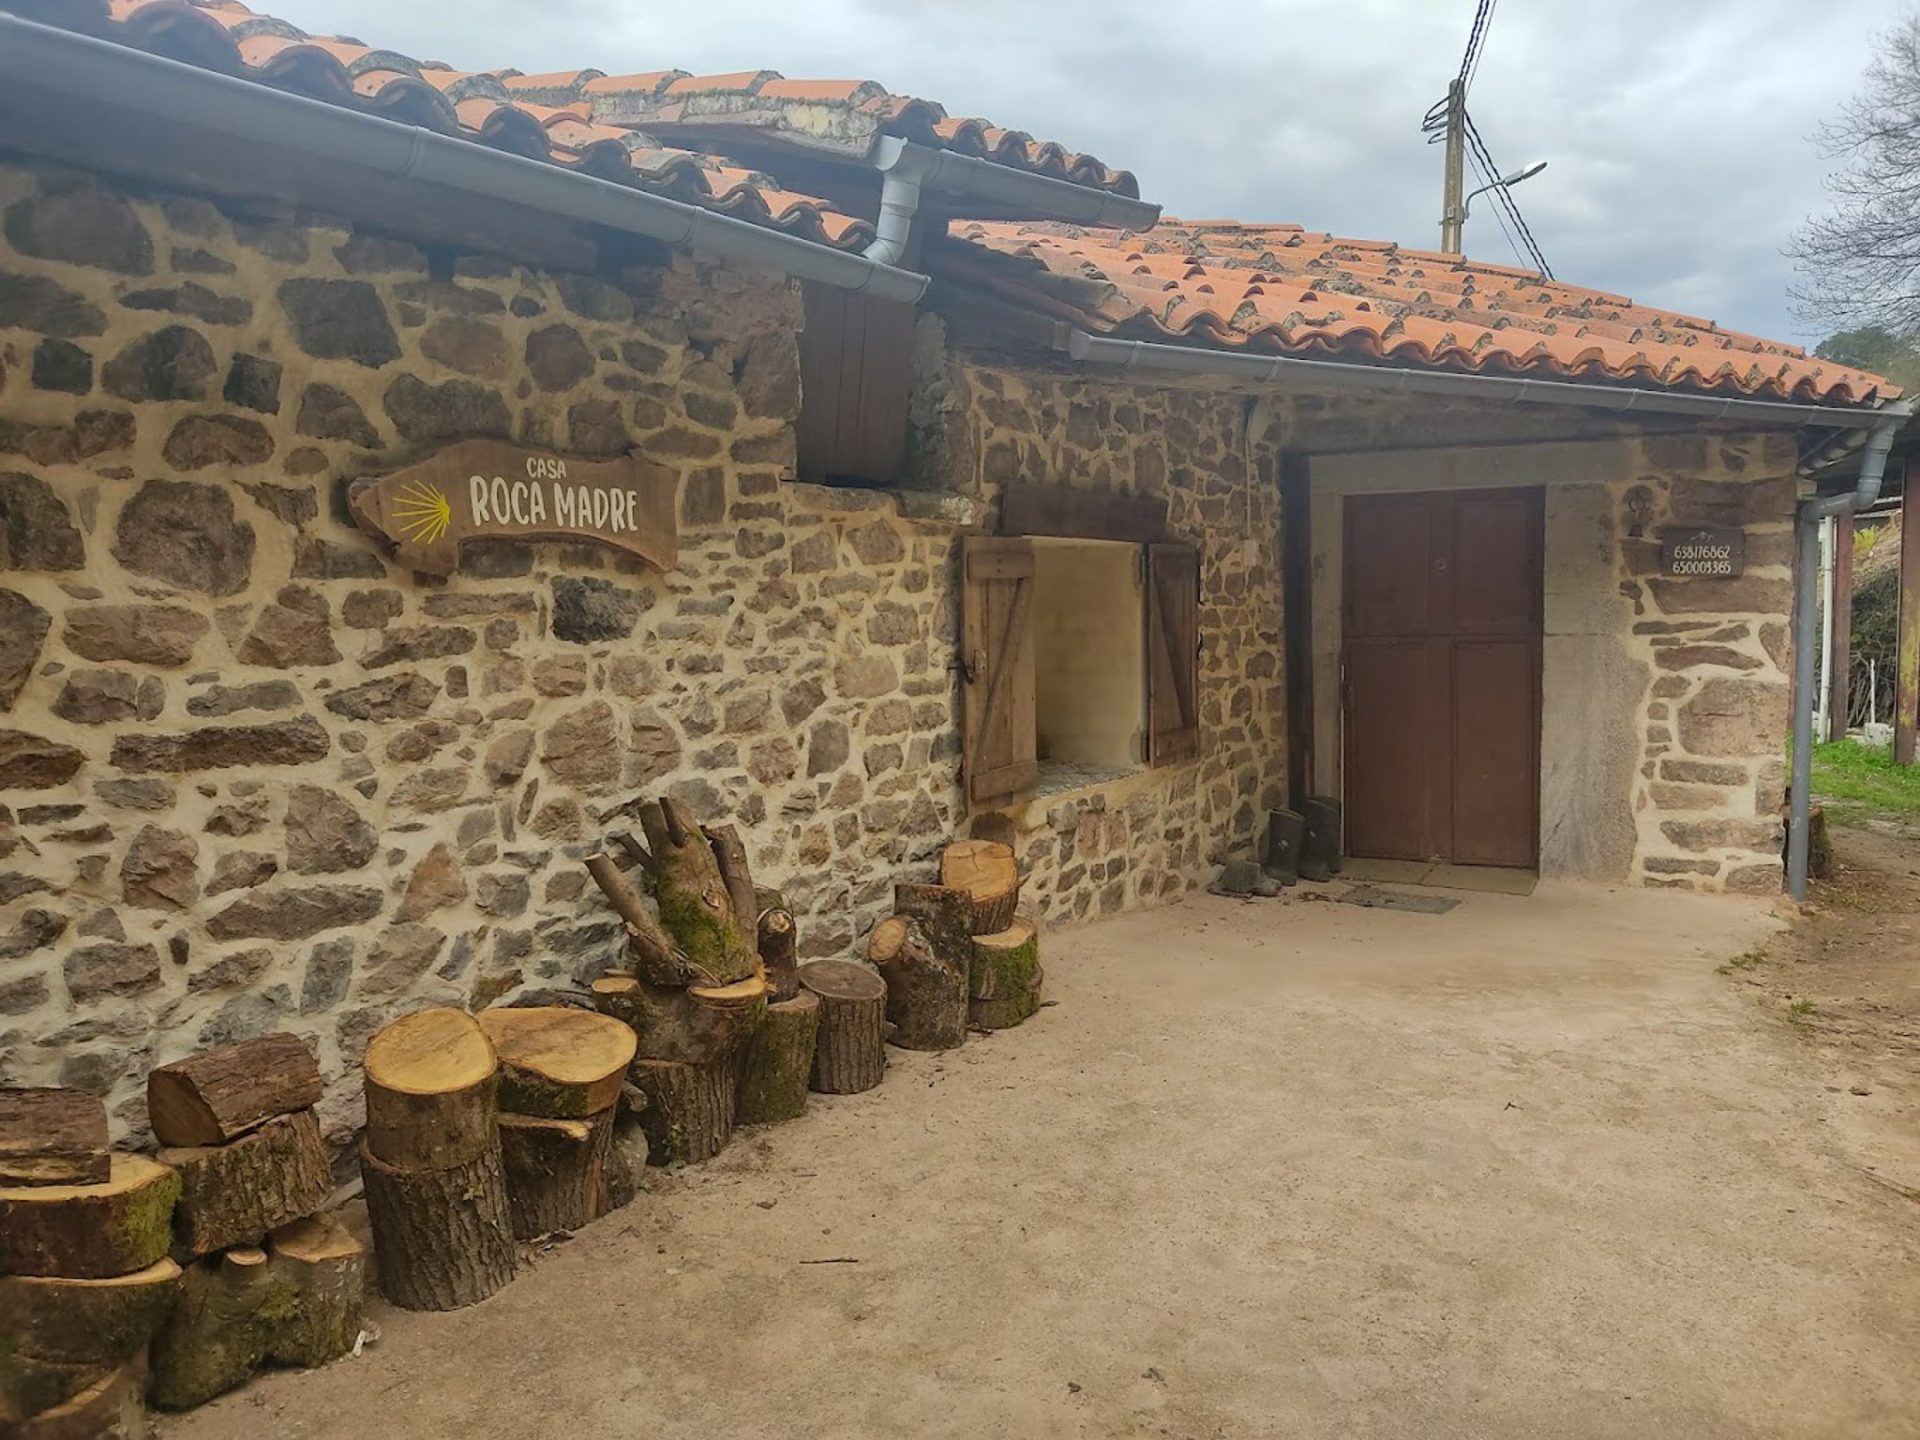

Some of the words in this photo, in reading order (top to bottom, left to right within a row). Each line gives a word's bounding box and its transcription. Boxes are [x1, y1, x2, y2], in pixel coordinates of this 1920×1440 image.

[526, 457, 567, 479] CASA
[469, 475, 547, 526] ROCA
[554, 482, 638, 532] MADRE
